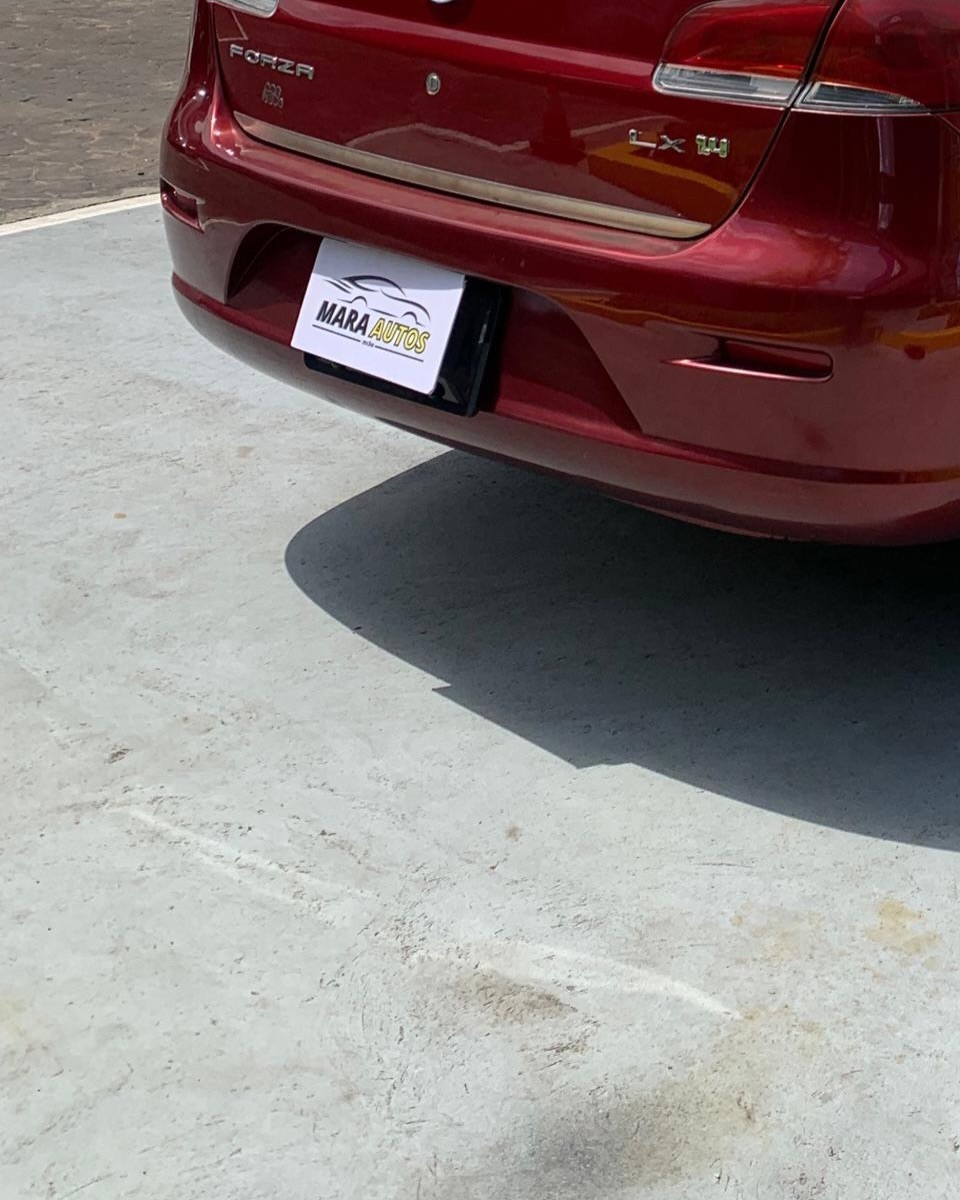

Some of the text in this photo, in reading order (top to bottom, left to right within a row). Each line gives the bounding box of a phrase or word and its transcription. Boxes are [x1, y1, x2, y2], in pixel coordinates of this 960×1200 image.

[229, 43, 315, 80] FORZA
[628, 128, 686, 154] LX
[316, 300, 430, 354] MARA AUTOS
